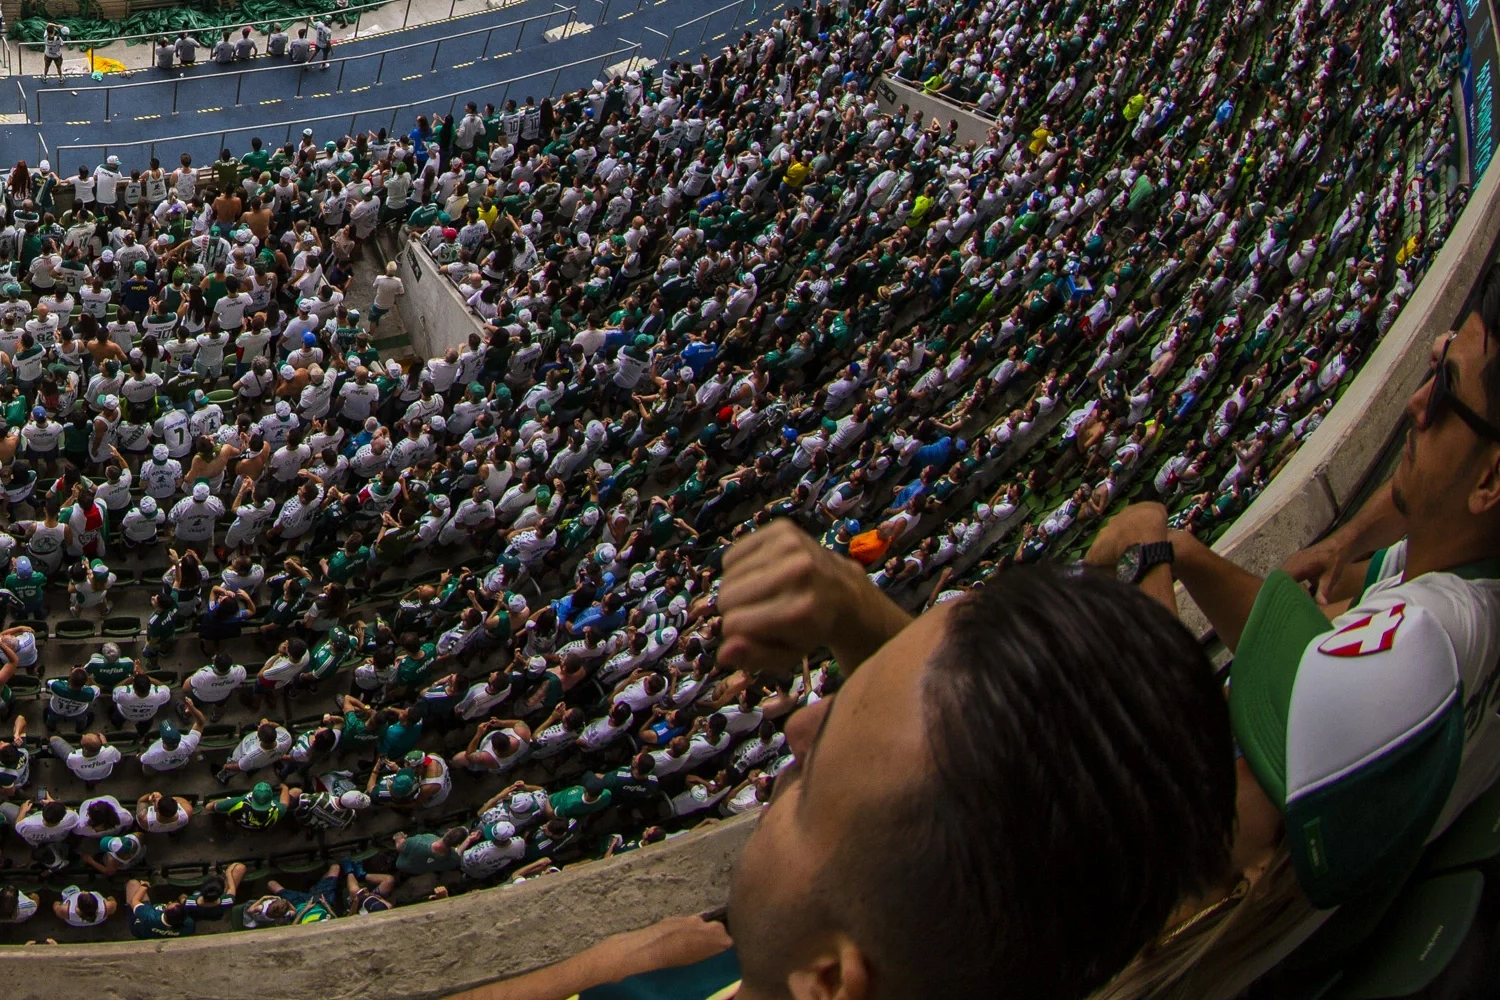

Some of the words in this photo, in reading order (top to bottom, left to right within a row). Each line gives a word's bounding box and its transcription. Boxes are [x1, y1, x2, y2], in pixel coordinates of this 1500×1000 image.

[99, 667, 124, 675] crefisa
[210, 679, 236, 687] crefisa
[80, 760, 107, 770] crefisa
[151, 926, 181, 937] crefisa
